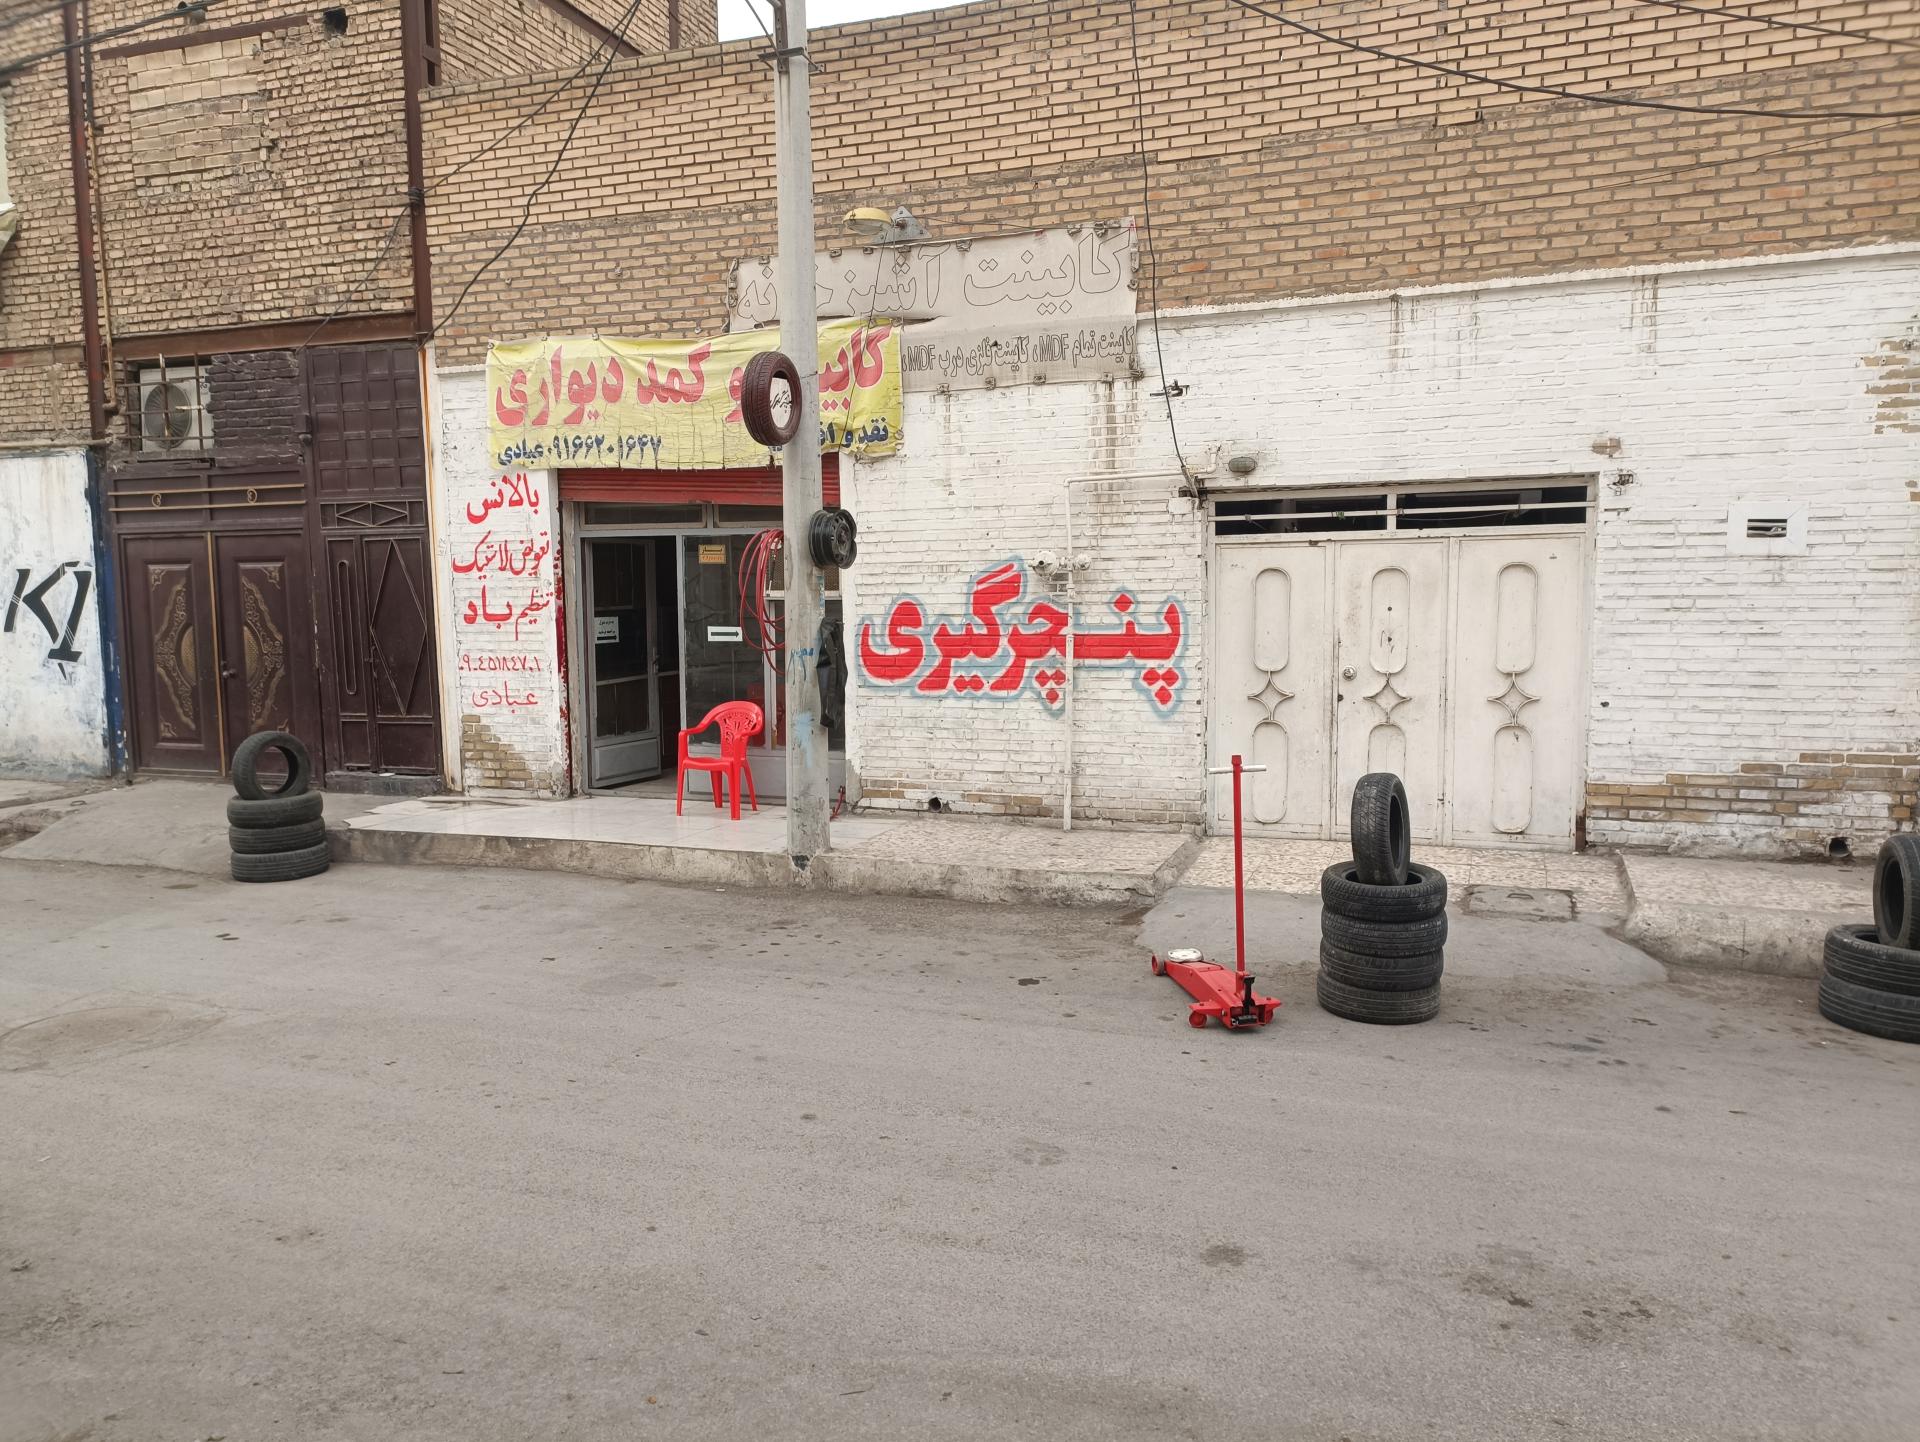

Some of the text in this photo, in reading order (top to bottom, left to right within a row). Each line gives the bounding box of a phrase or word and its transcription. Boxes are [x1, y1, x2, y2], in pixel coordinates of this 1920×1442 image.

[963, 229, 1131, 316] کابینت
[495, 344, 624, 426] دیواری
[637, 342, 712, 405] کمد
[857, 416, 889, 445] نقد
[466, 472, 540, 525] بالانس
[452, 530, 550, 580] تعویض لاستیک
[463, 584, 554, 641] تنظیم باد
[472, 680, 539, 714] عبادی
